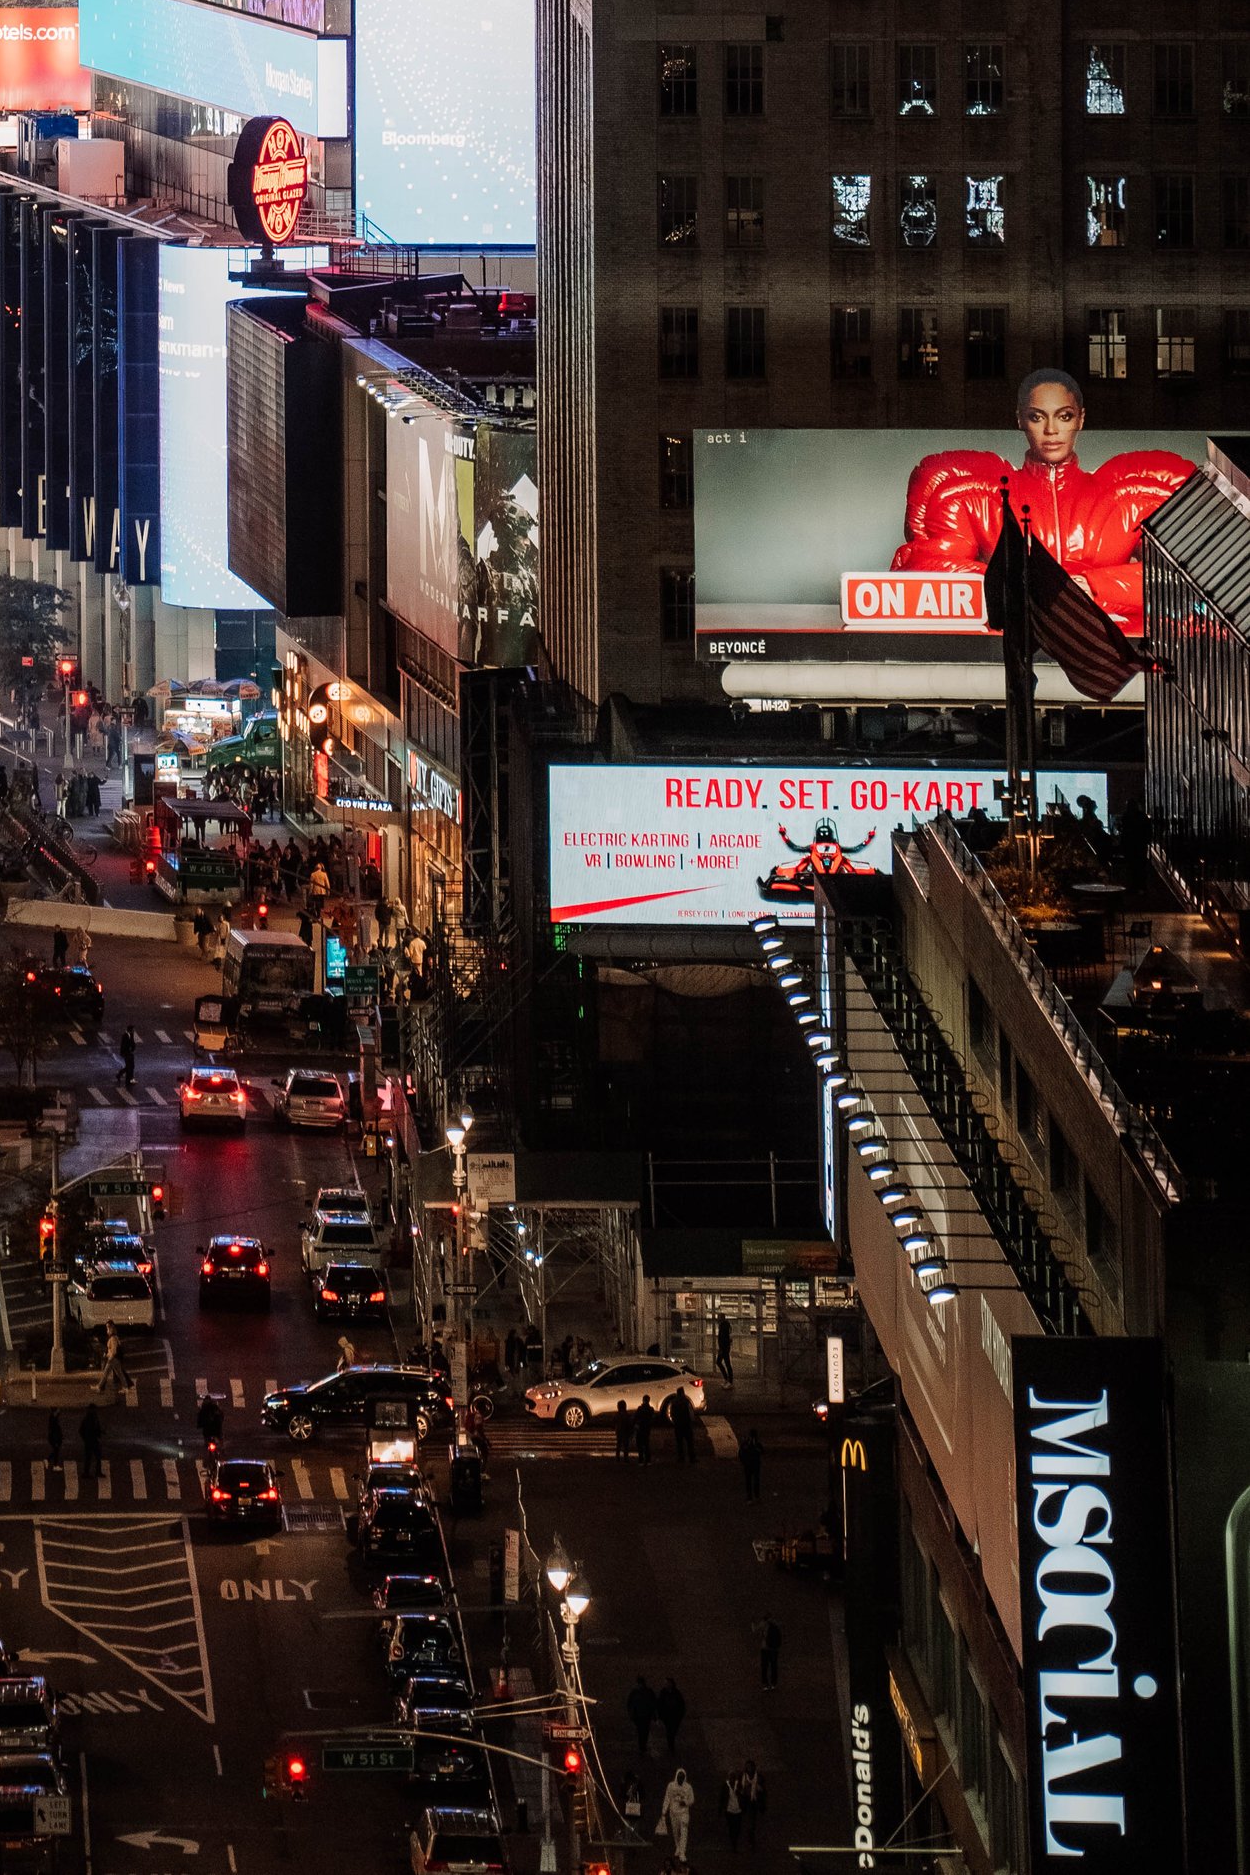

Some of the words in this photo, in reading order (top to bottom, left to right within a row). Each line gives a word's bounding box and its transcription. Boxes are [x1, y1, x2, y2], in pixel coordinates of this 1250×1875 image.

[265, 61, 290, 98] Morgan
[290, 68, 313, 107] Stanley
[267, 129, 292, 158] HOT
[381, 131, 466, 148] Bloomberg
[255, 190, 282, 205] ORIGINAL
[282, 187, 303, 200] GLAZED
[267, 203, 293, 234] NOW
[707, 431, 732, 445] act
[738, 431, 747, 445] i
[854, 583, 906, 617] ON
[916, 584, 975, 617] AIR
[709, 639, 767, 655] BEYONCÉ
[762, 698, 791, 713] M-120
[430, 769, 453, 819] GIFTS
[664, 778, 769, 810] READY.
[779, 778, 840, 811] SET.
[850, 779, 983, 813] GO-KART
[369, 800, 393, 812] PLAZA
[564, 832, 628, 848] ELECTRIC
[630, 833, 690, 848] KARTING
[708, 833, 762, 849] ARCADE
[200, 864, 212, 875] 49
[584, 853, 602, 868] VR
[614, 853, 676, 869] BOWLING
[703, 910, 719, 918] CITY
[728, 910, 746, 918] LONG
[114, 1184, 131, 1193] 50
[220, 1579, 320, 1601] ONLY
[57, 1687, 164, 1716] ONLY
[342, 1753, 354, 1766] W
[359, 1753, 374, 1766] 51
[379, 1753, 395, 1766] St
